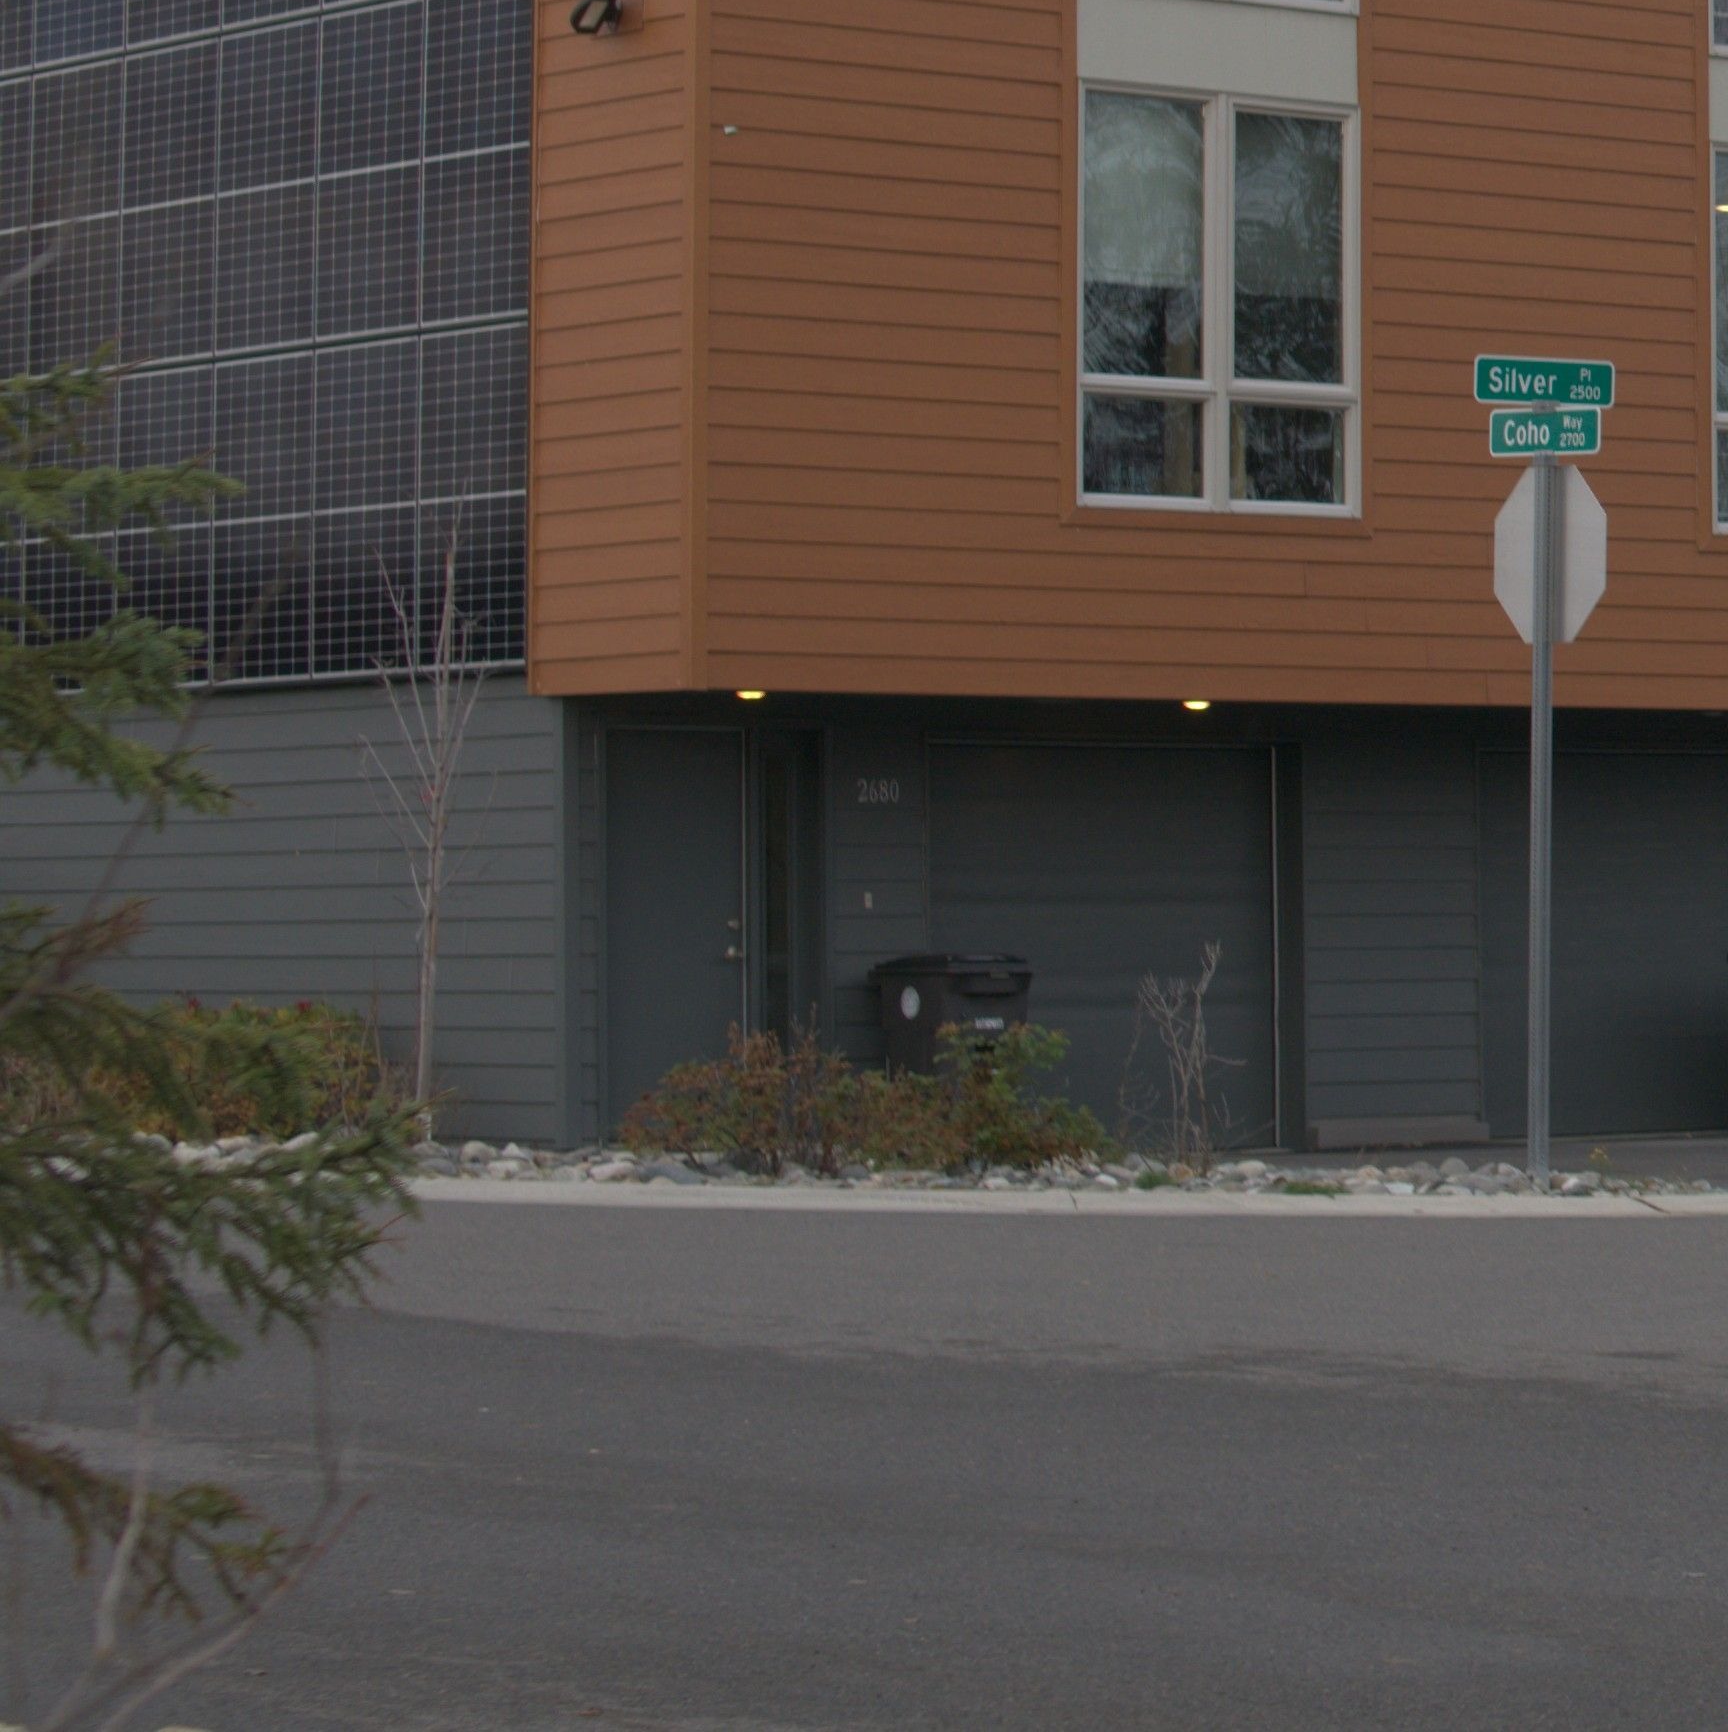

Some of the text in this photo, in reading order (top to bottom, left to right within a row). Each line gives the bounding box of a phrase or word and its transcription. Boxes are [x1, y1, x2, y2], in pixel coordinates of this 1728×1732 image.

[1489, 366, 1591, 395] Silver Pl
[1570, 385, 1601, 400] 2500
[1504, 415, 1582, 447] Coho Way
[1559, 432, 1585, 448] 2700
[856, 778, 900, 804] 2680
